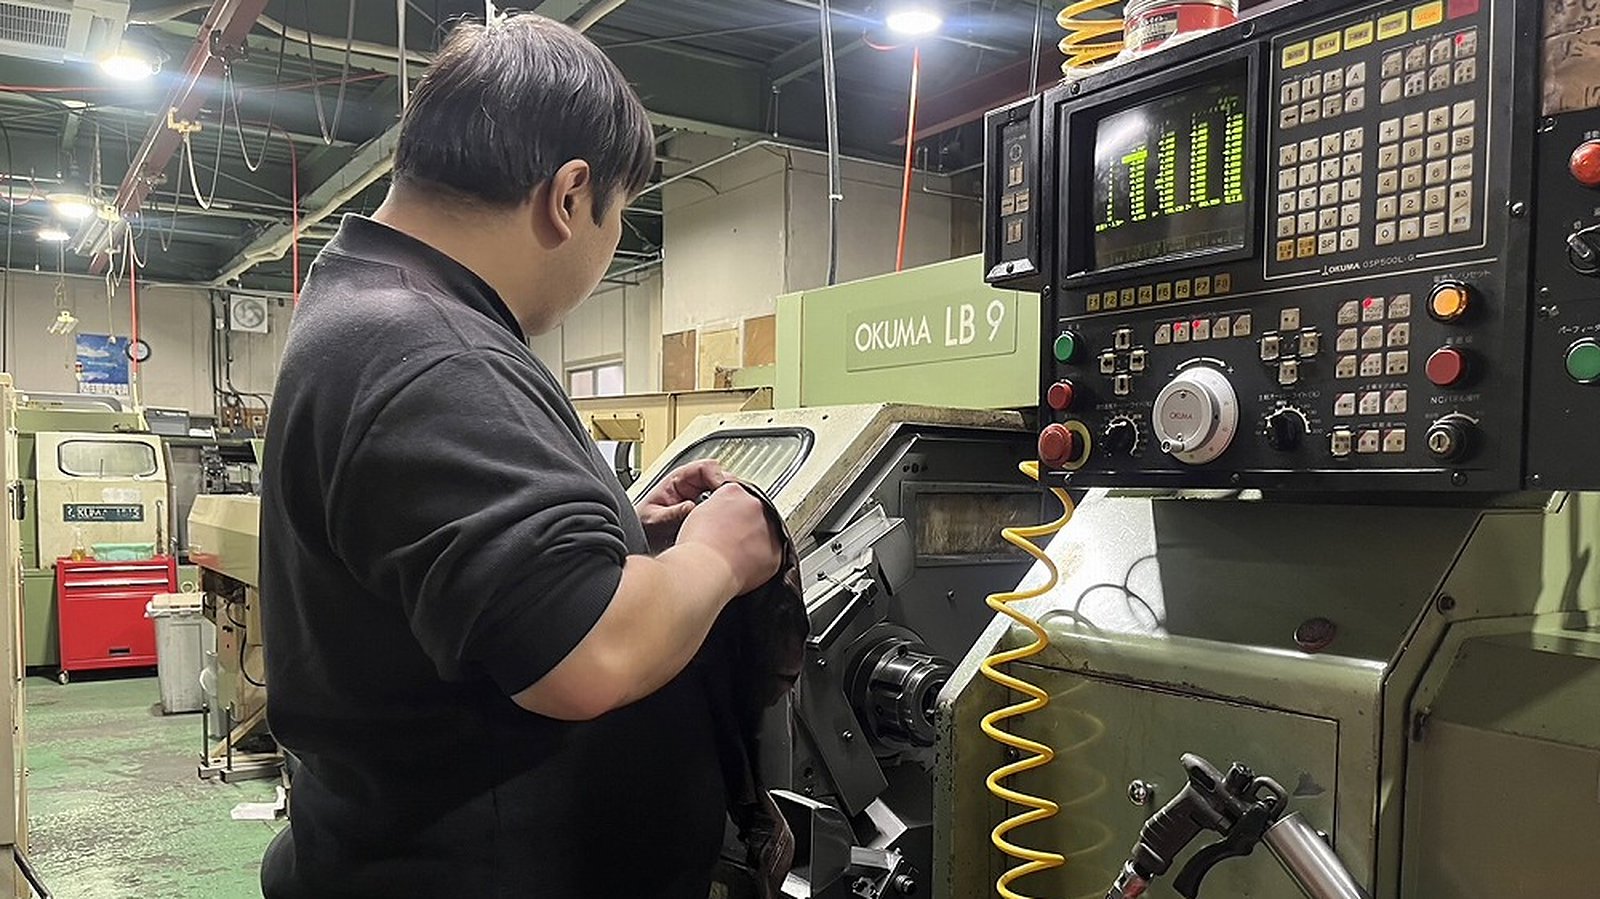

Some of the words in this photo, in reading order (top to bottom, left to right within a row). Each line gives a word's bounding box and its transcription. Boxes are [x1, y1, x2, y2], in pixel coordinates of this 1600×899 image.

[1455, 135, 1470, 147] BS
[1321, 239, 1335, 249] SP
[1328, 262, 1360, 274] OKUMA
[1196, 280, 1208, 292] F7
[1215, 277, 1228, 289] F8
[1140, 289, 1151, 299] F4
[1158, 287, 1169, 297] F5
[1177, 284, 1188, 294] F6
[1089, 297, 1098, 306] F1
[1105, 294, 1116, 304] F2
[1122, 291, 1133, 302] F3
[855, 315, 932, 352] OKUMA
[945, 303, 976, 347] LB
[986, 299, 1005, 342] 9
[1168, 411, 1193, 420] OKUMA
